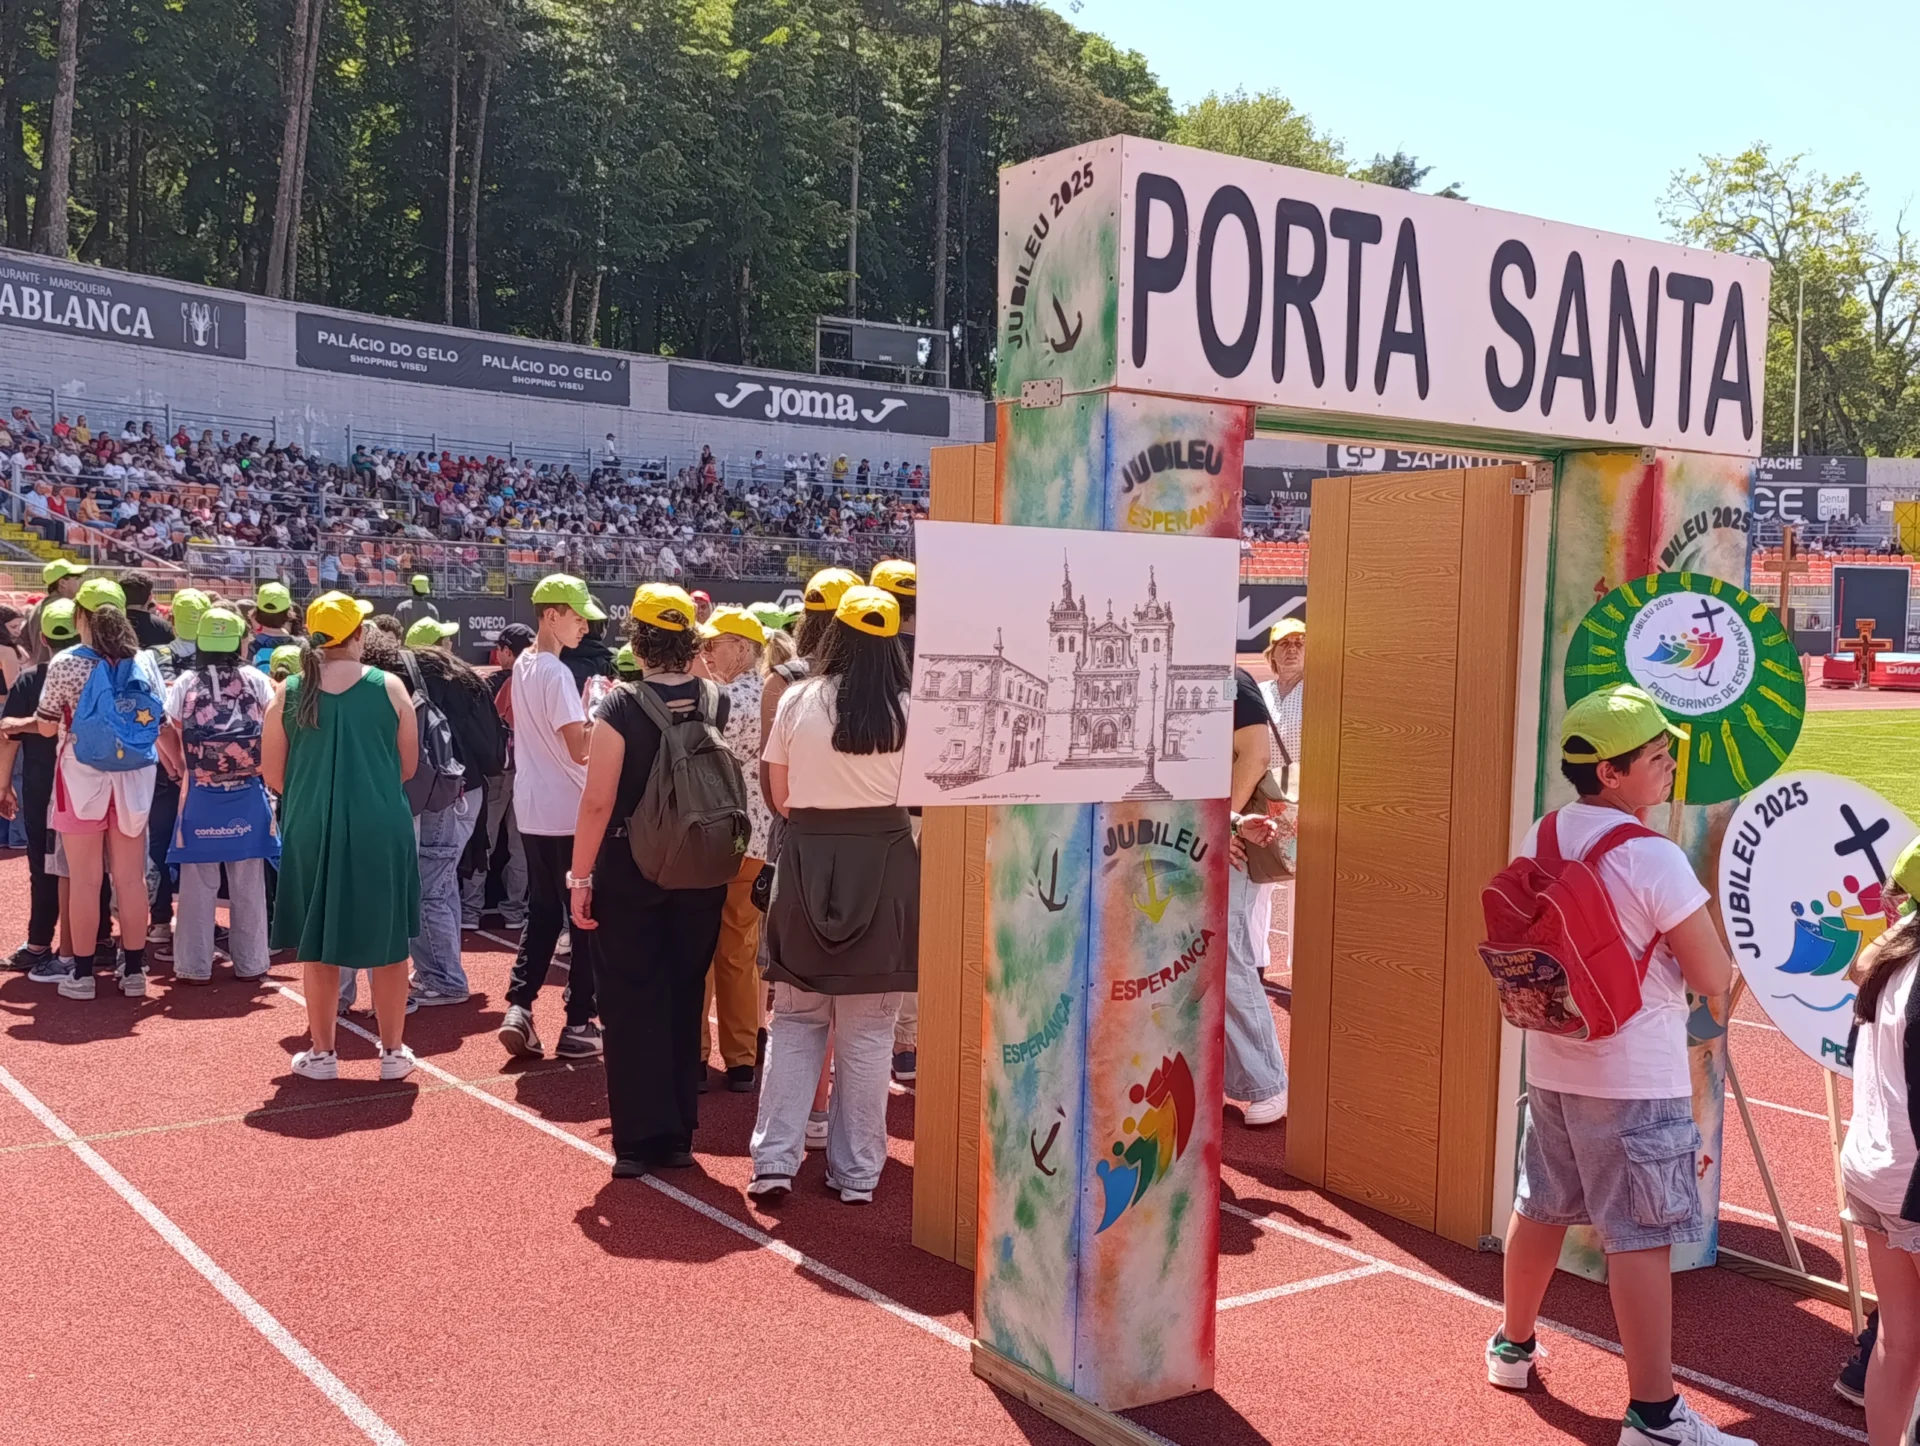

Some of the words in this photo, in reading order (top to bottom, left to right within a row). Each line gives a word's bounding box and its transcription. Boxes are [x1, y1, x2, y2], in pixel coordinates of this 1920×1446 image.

[1008, 213, 1050, 349] JUBILEU
[1050, 162, 1094, 218] 2025
[49, 276, 112, 297] MARISQUEIRA
[0, 283, 154, 339] ABLANCA
[1132, 172, 1429, 400] PORTA
[1485, 239, 1753, 441] SANTA
[317, 330, 385, 353] PALÁCIO
[390, 342, 412, 357] DO
[416, 346, 458, 363] GELO
[350, 354, 398, 370] SHOPPING
[401, 361, 428, 372] VISEU
[482, 354, 543, 373] PALÁCIO
[549, 364, 570, 378] DO
[573, 367, 612, 382] GELO
[512, 375, 556, 388] SHOPPING
[559, 381, 584, 391] VISEU
[1122, 439, 1223, 493] JUBILEU
[1270, 490, 1308, 501] VIRIATO
[1819, 494, 1848, 504] Dental
[1712, 506, 1752, 533] 2025
[1819, 505, 1847, 516] Clinic
[468, 616, 506, 629] SOVECO
[1633, 607, 1655, 639] JUBILEU
[1655, 597, 1674, 611] 2025
[1727, 616, 1749, 686] ESPERANÇA
[1648, 682, 1722, 709] PEREGRINOS
[1720, 682, 1738, 700] DE
[1103, 819, 1208, 862] JUBILEU
[1729, 821, 1761, 958] JUBILEU
[1755, 781, 1809, 828] 2025
[1110, 928, 1216, 1001] ESPERANÇA
[1504, 963, 1534, 977] DECK!
[1507, 951, 1536, 965] PAWS
[1002, 992, 1074, 1065] ESPERANÇA
